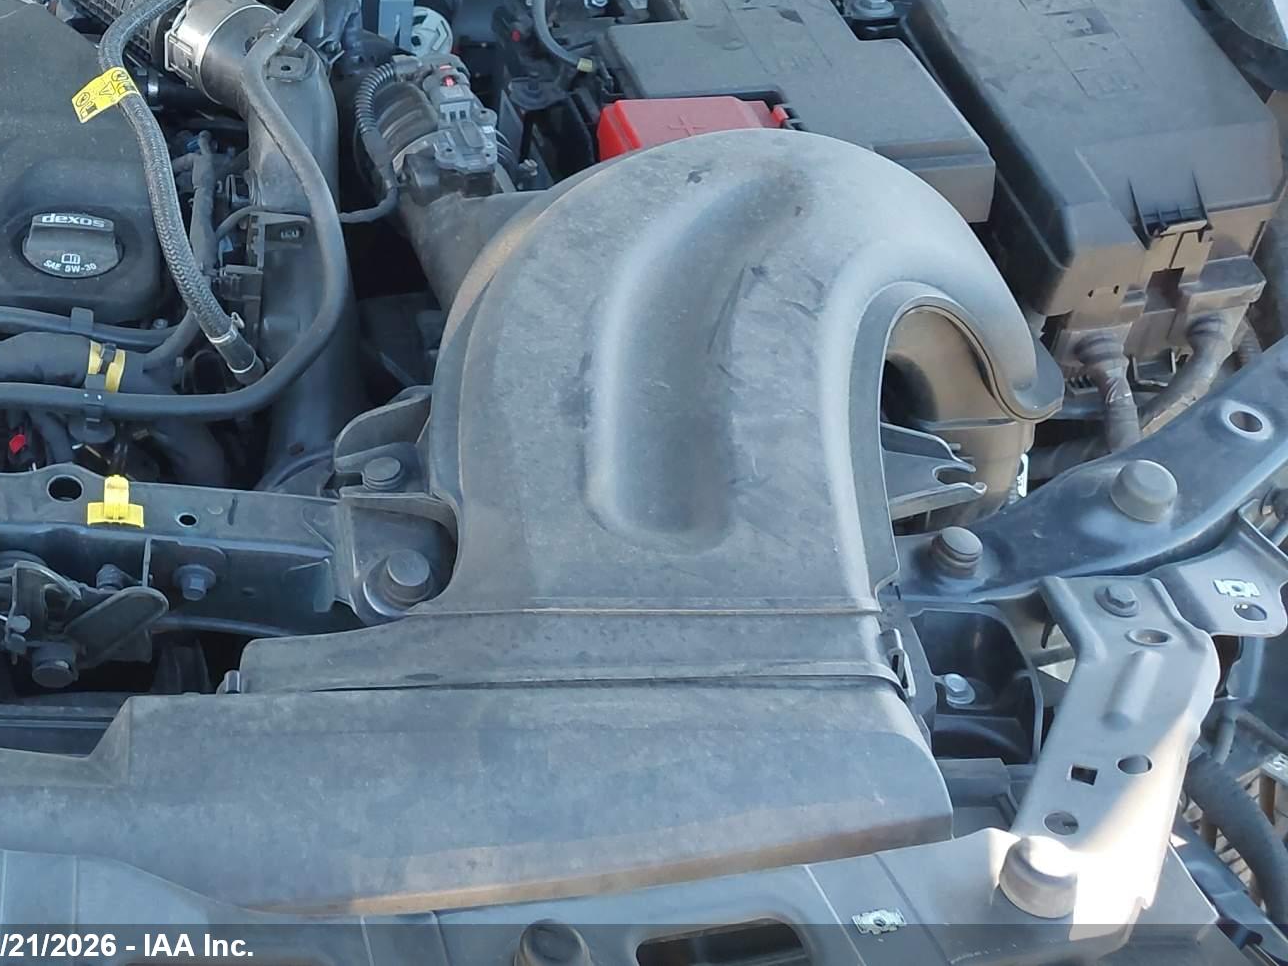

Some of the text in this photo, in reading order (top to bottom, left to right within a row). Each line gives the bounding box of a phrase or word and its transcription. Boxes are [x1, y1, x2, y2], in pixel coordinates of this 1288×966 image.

[41, 213, 105, 228] dexos
[43, 259, 97, 273] SAE 5W-30
